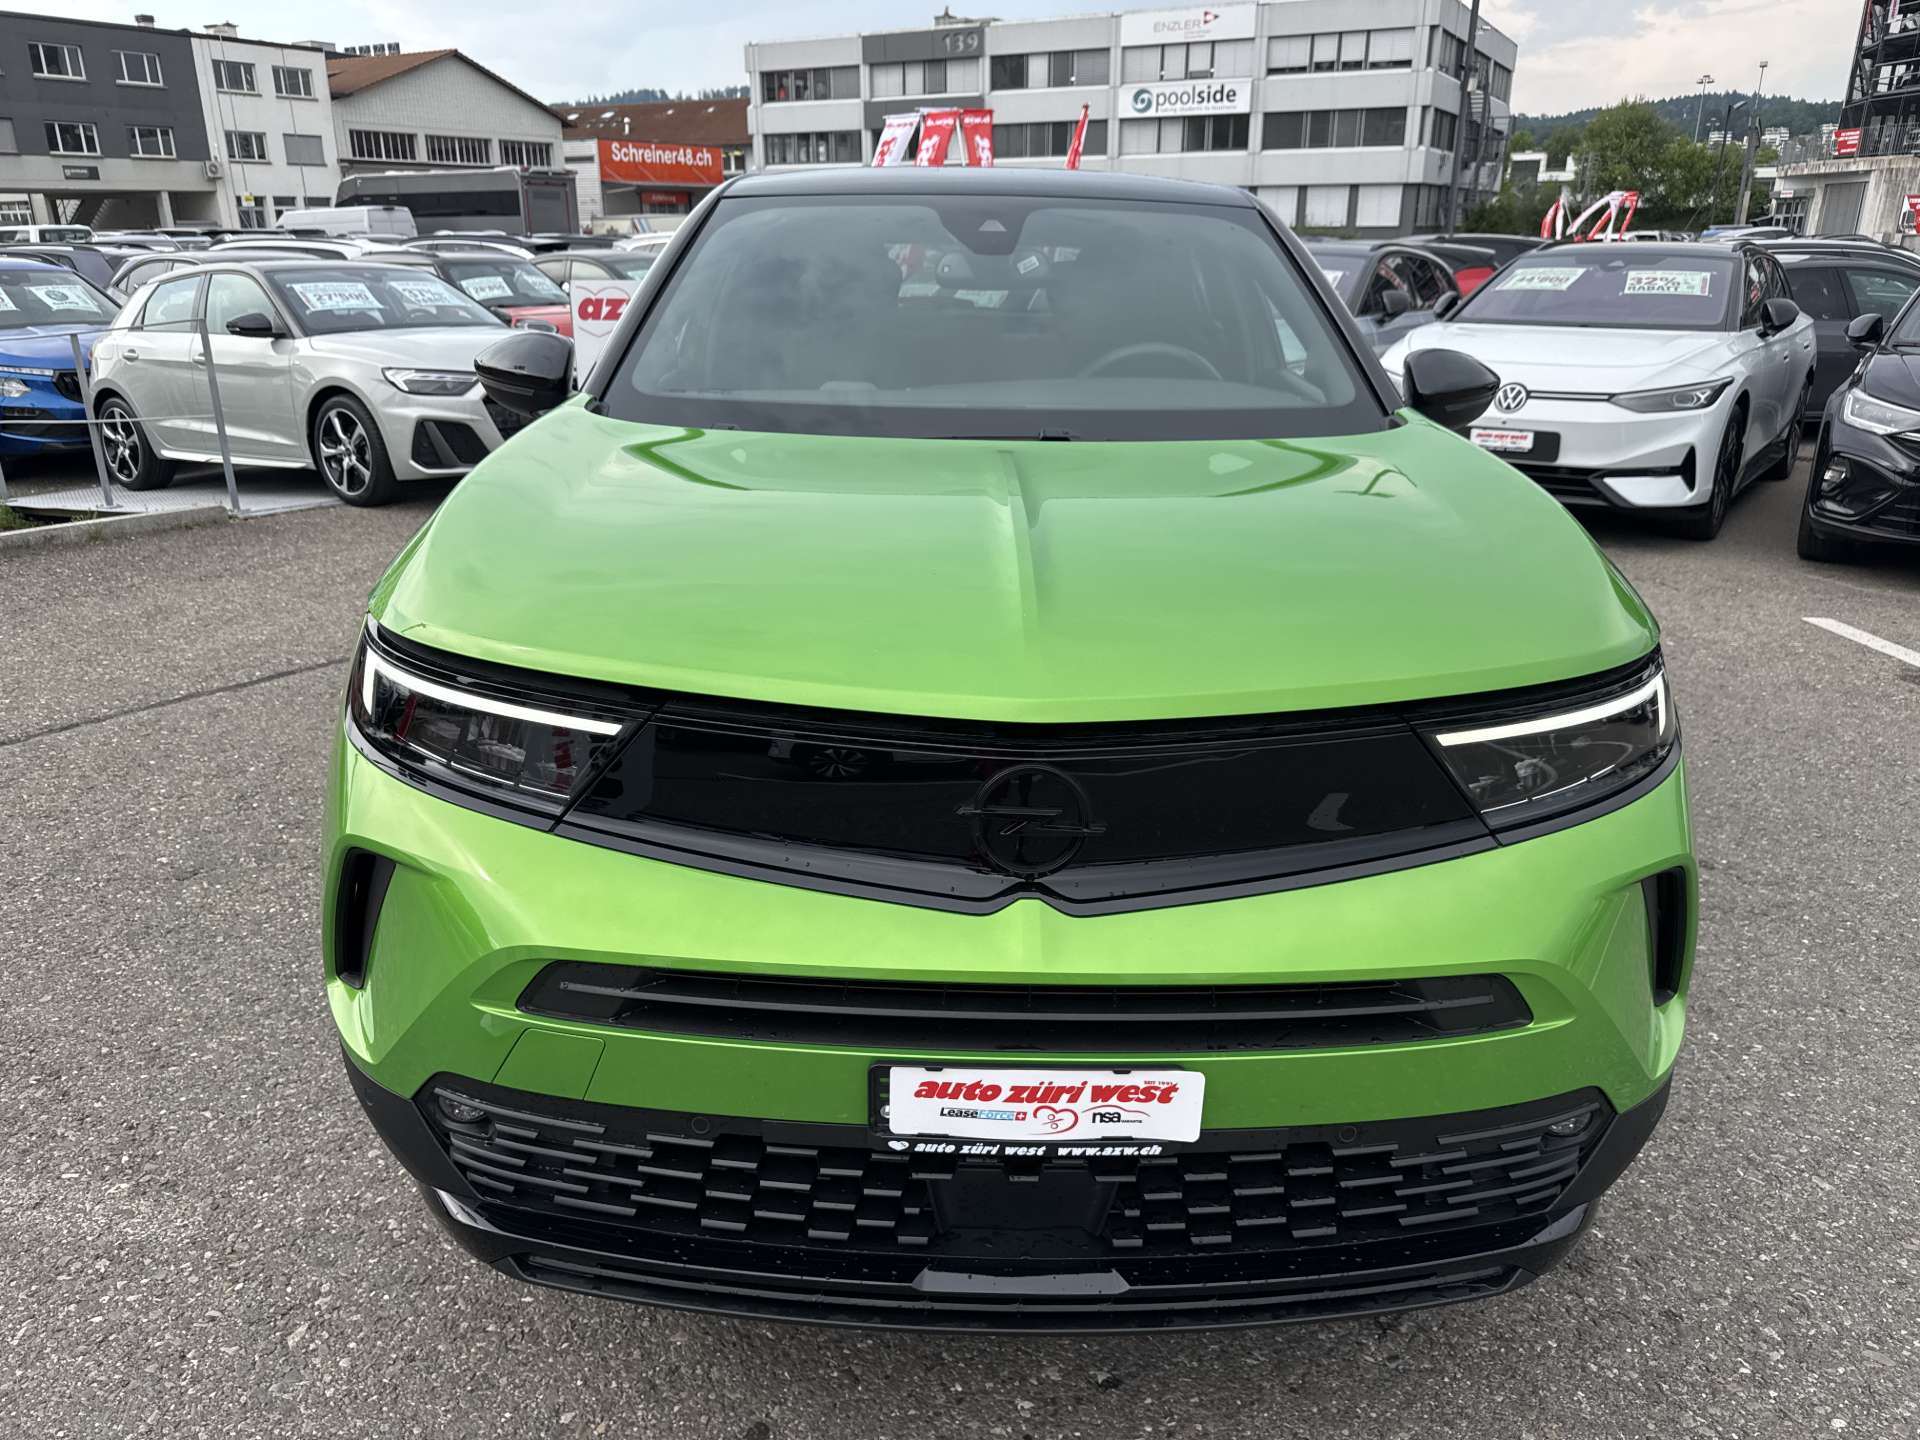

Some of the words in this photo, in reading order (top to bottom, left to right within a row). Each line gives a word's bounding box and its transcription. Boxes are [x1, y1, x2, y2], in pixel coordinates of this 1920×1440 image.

[1153, 19, 1202, 33] ENZLER
[942, 32, 979, 52] 139
[1155, 84, 1237, 113] poolside
[611, 142, 713, 167] Schreiner48.ch
[1627, 285, 1681, 293] RABATT
[578, 297, 631, 321] az
[914, 1080, 1002, 1102] auto
[1002, 1081, 1088, 1104] züri
[1090, 1082, 1180, 1104] west
[939, 1107, 1015, 1120] LeaseForce
[1092, 1111, 1121, 1123] nsa
[914, 1142, 956, 1154] auto
[959, 1143, 1000, 1155] züri
[1004, 1145, 1047, 1156] west
[1057, 1145, 1163, 1156] www.azw.ch
